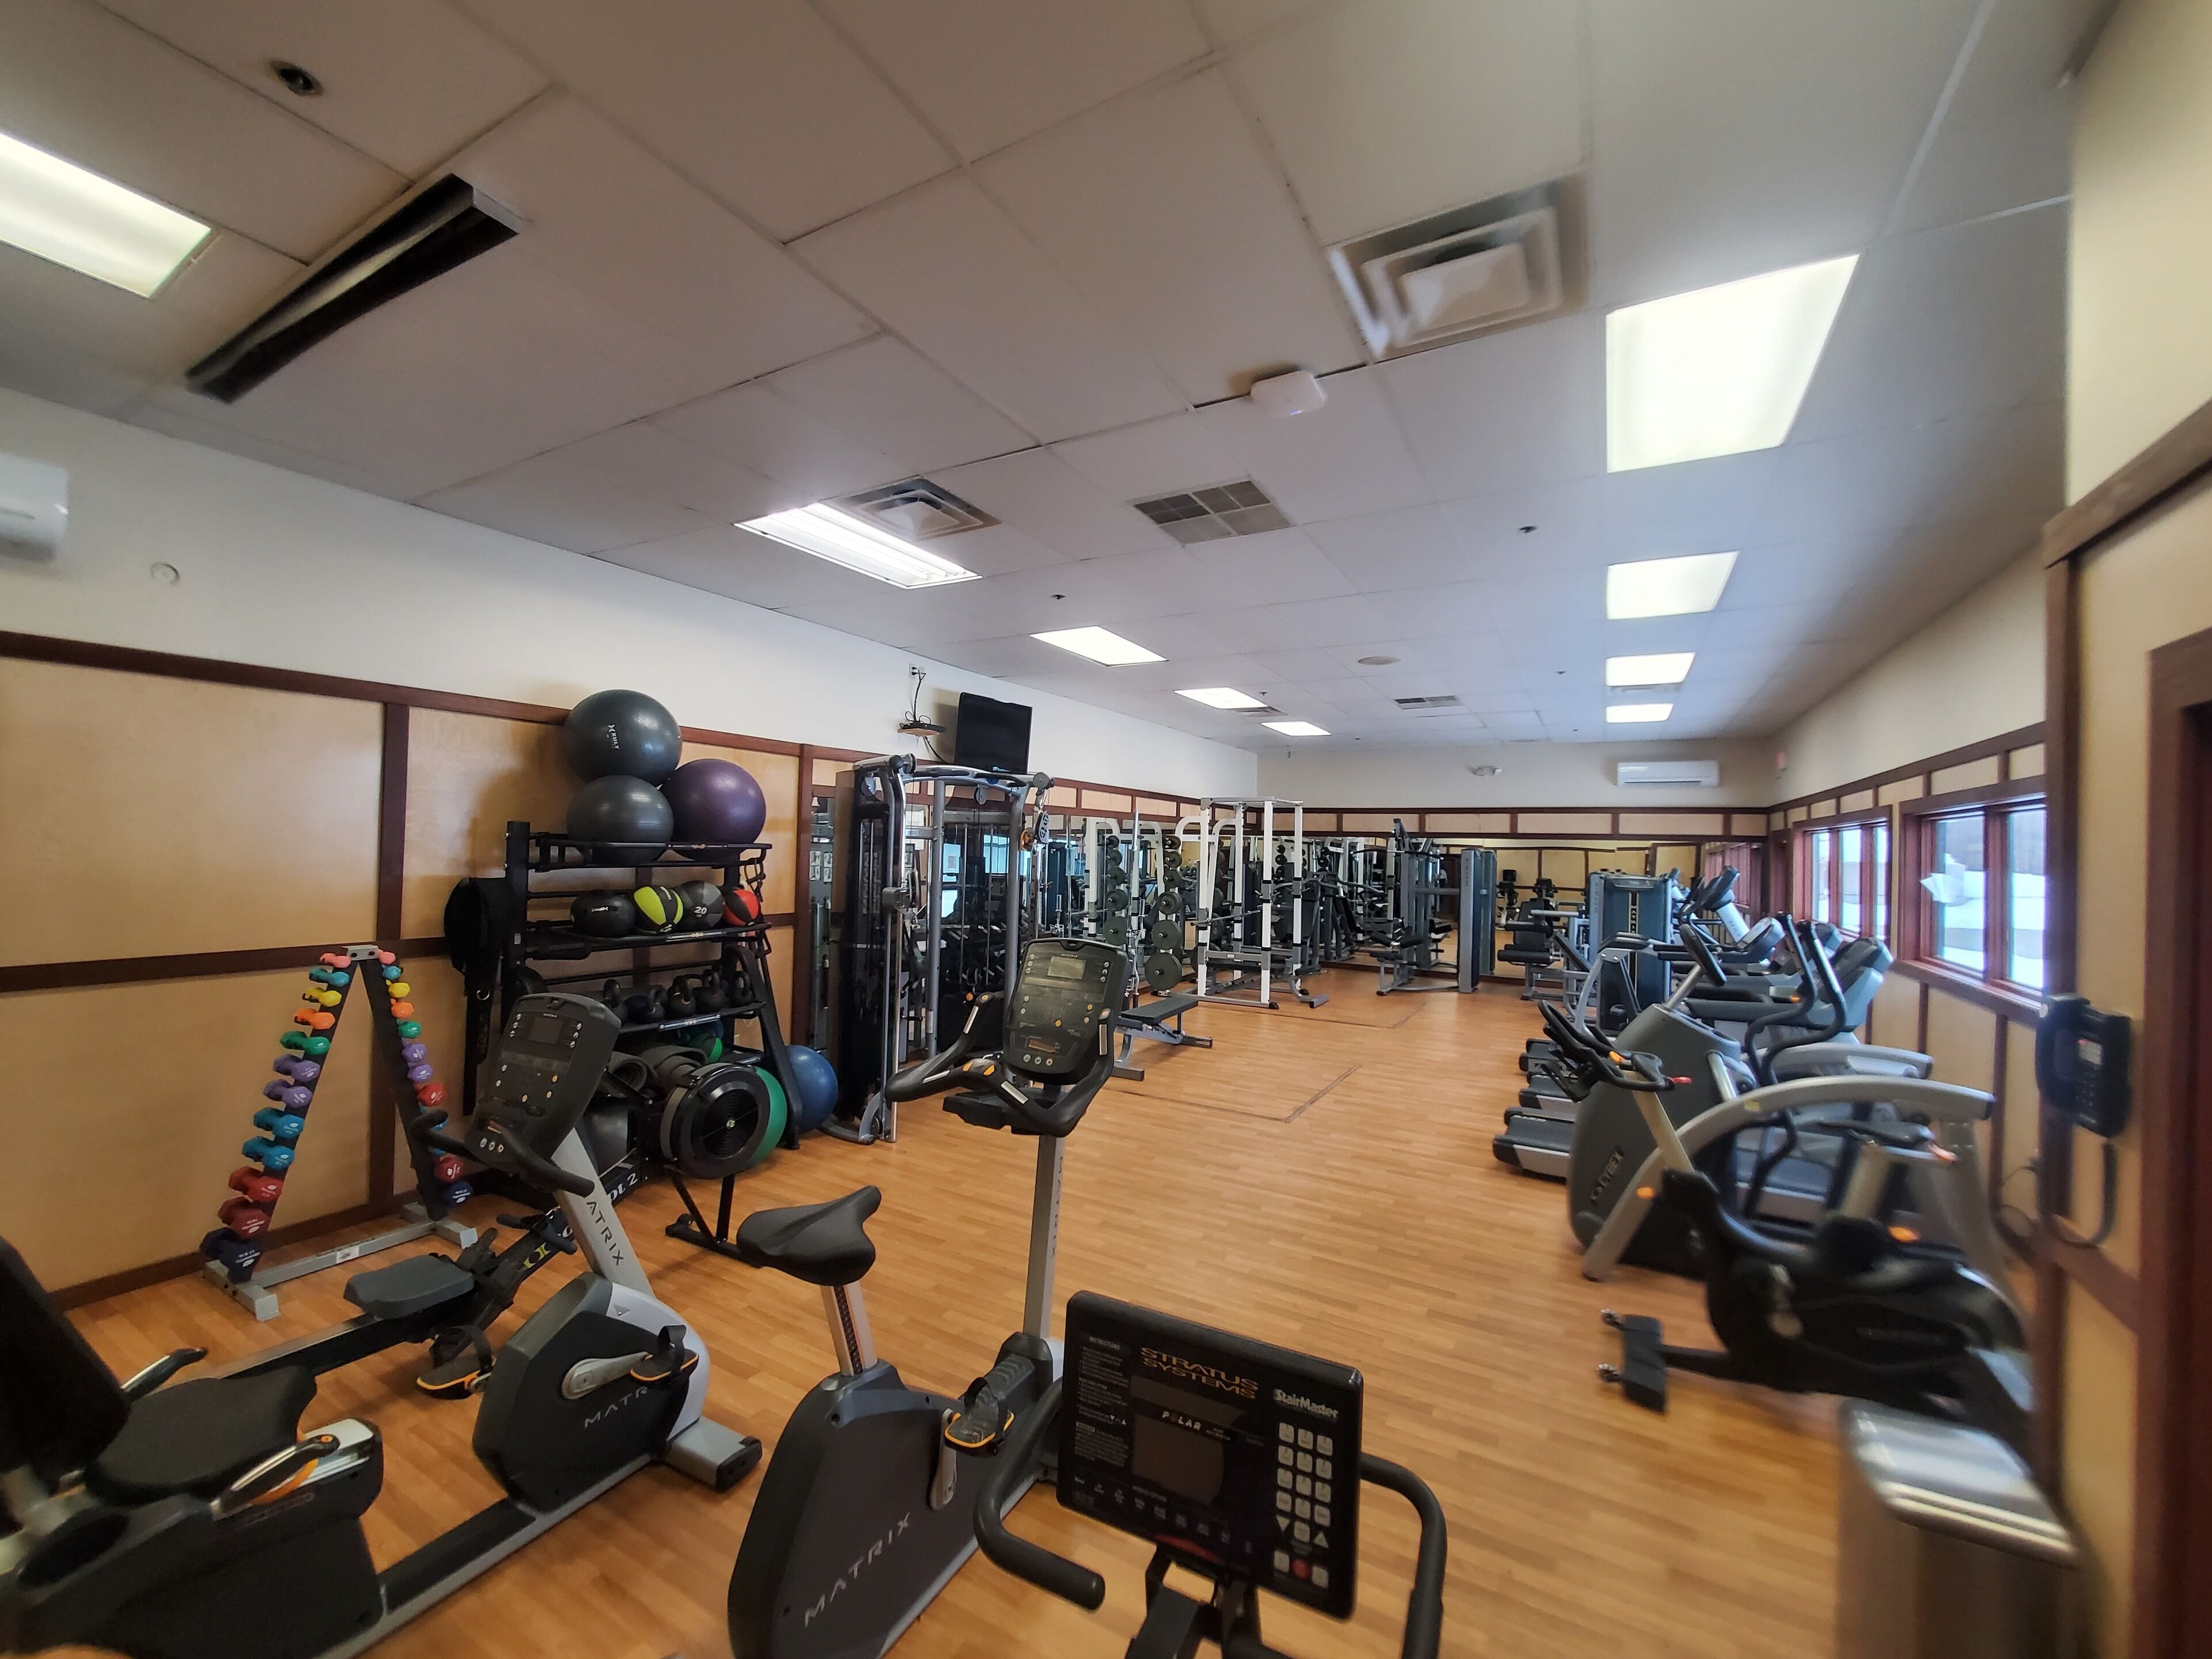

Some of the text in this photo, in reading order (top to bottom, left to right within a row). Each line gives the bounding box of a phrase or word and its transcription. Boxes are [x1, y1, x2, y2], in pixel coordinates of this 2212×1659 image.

[694, 906, 707, 915] 20
[627, 1173, 638, 1186] 2
[586, 1201, 624, 1266] ATRIX
[1141, 1347, 1259, 1391] STRATUS
[1143, 1357, 1256, 1399] SYSTEMS
[585, 1385, 648, 1429] MATR
[1162, 1411, 1202, 1430] POLAR
[1273, 1388, 1339, 1419] StairMaster
[805, 1512, 911, 1627] MATRIX
